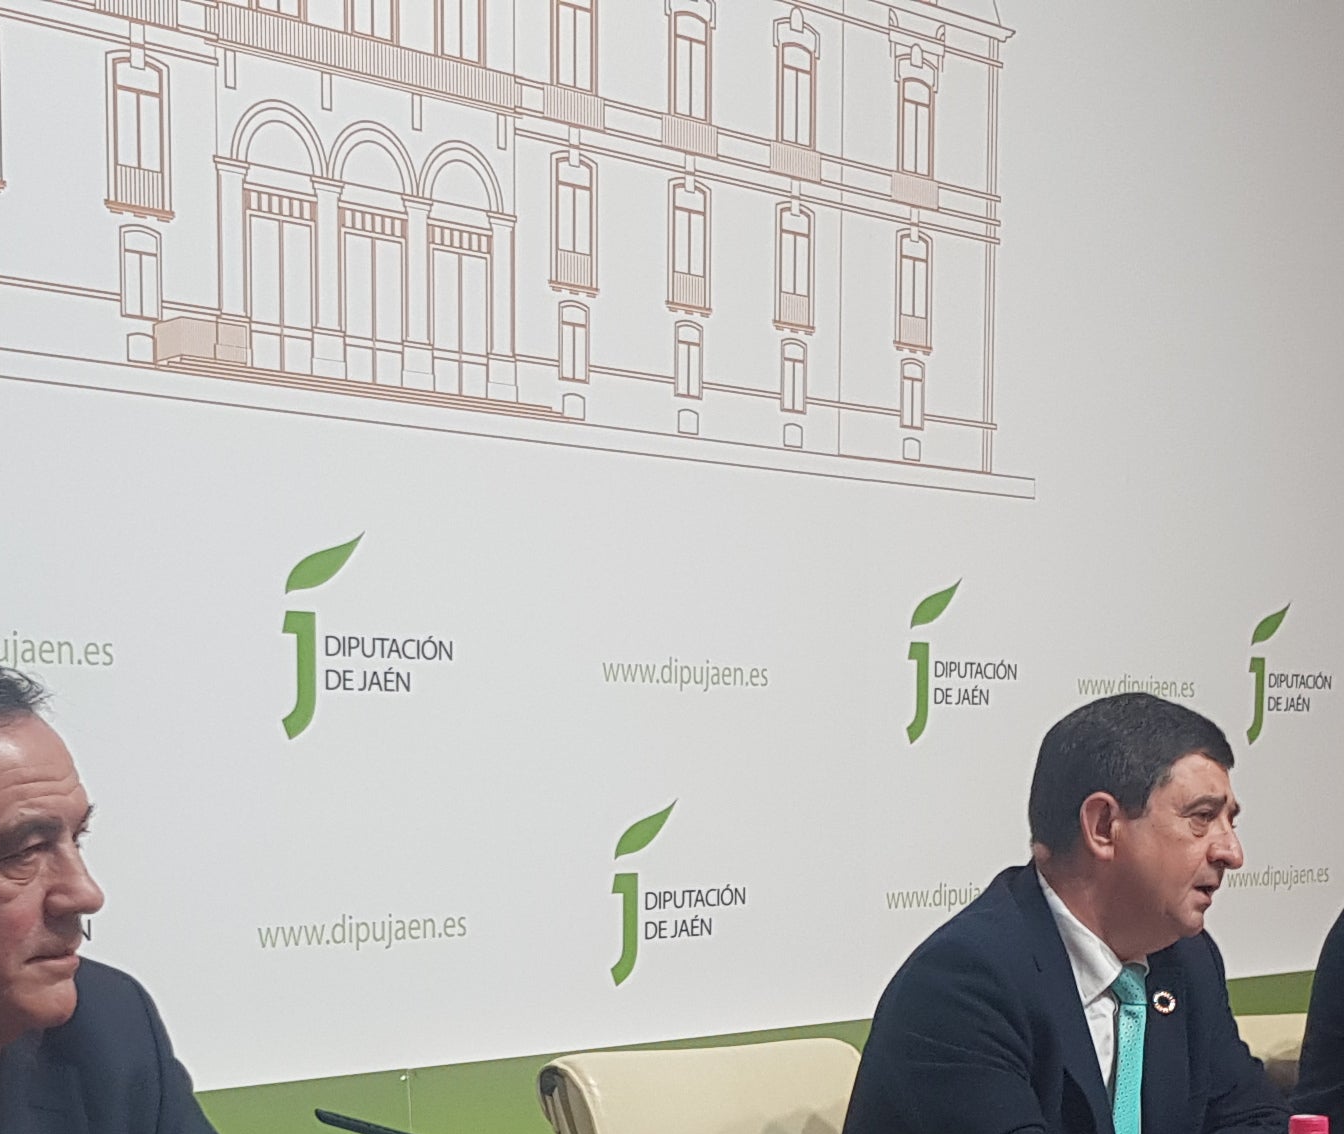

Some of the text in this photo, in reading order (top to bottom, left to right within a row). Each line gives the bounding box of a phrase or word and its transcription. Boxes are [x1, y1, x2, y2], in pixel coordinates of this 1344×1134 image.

[325, 636, 452, 660] DIPUTACIÓN
[324, 667, 410, 692] DE JAÉN
[602, 656, 769, 692] www.dipujaen.es
[935, 660, 1017, 680] DIPUTACIÓN
[1269, 672, 1332, 689] DIPUTACIÓN
[934, 685, 989, 705] DE JAÉN
[1267, 693, 1311, 712] DE JAÉN
[1227, 865, 1329, 891] www.dipujaen.es
[645, 884, 745, 910] DIPUTACIÓN
[257, 911, 467, 951] www.dipujaen.es
[644, 917, 712, 940] DE JAÉN
